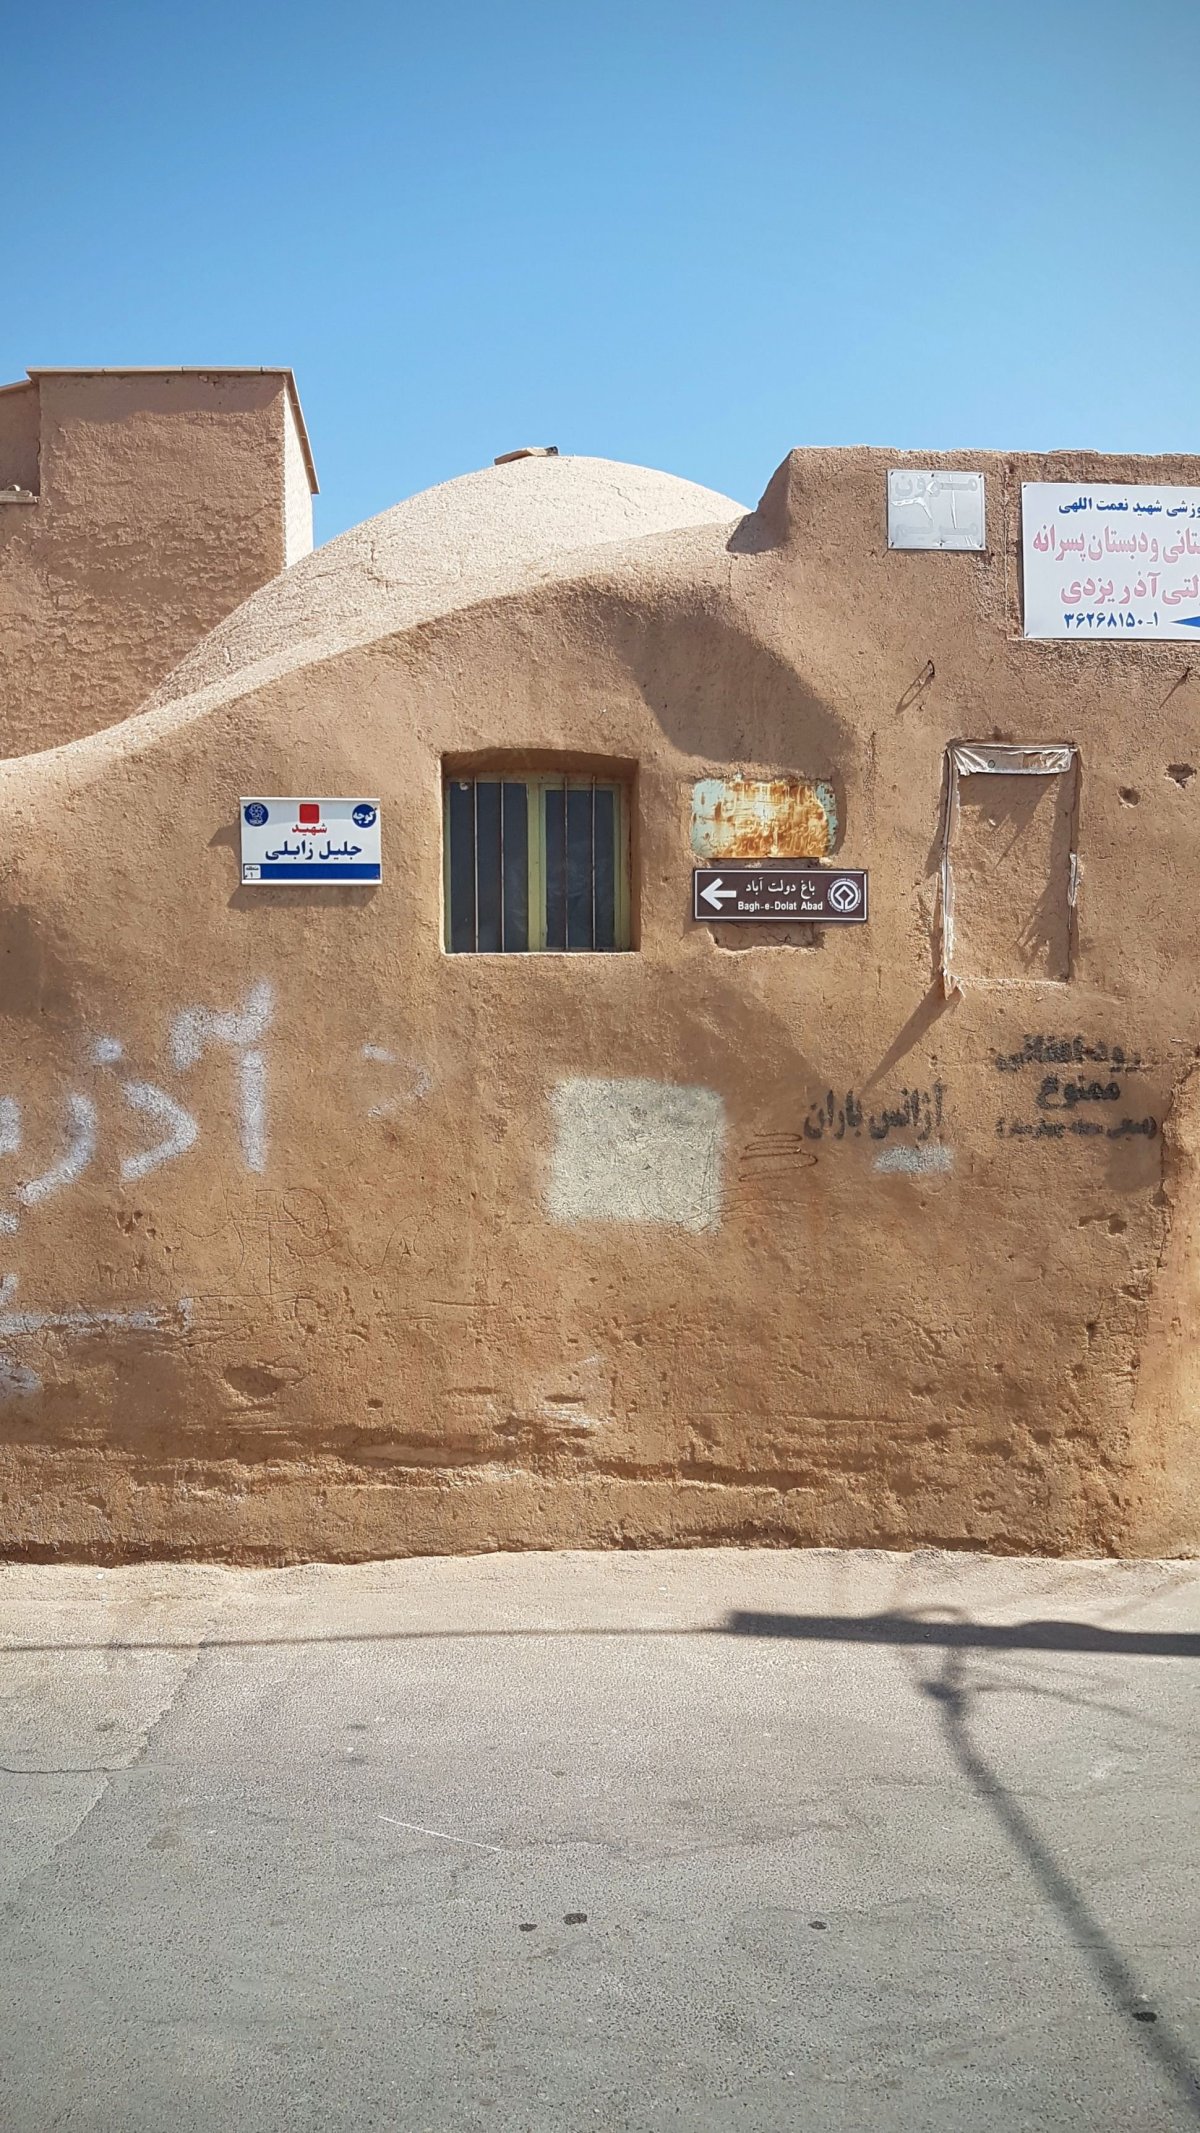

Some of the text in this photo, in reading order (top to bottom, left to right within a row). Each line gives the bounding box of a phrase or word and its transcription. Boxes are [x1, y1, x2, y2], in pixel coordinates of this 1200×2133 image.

[1058, 497, 1092, 514] اللهی
[1096, 498, 1129, 512] نعمت
[1133, 500, 1162, 516] شهید
[1032, 523, 1086, 562] پسرانه
[1162, 574, 1200, 605] لتی
[352, 810, 375, 825] کوچه
[291, 823, 328, 836] شهید
[265, 839, 362, 861] جلیل زابلی
[745, 877, 764, 895] آباد
[767, 879, 796, 895] دولت
[800, 879, 816, 899] باغ
[738, 901, 823, 912] Bagh-e-Dolat Abad
[1036, 1072, 1121, 1109] ممنوع
[803, 1089, 862, 1140] باران
